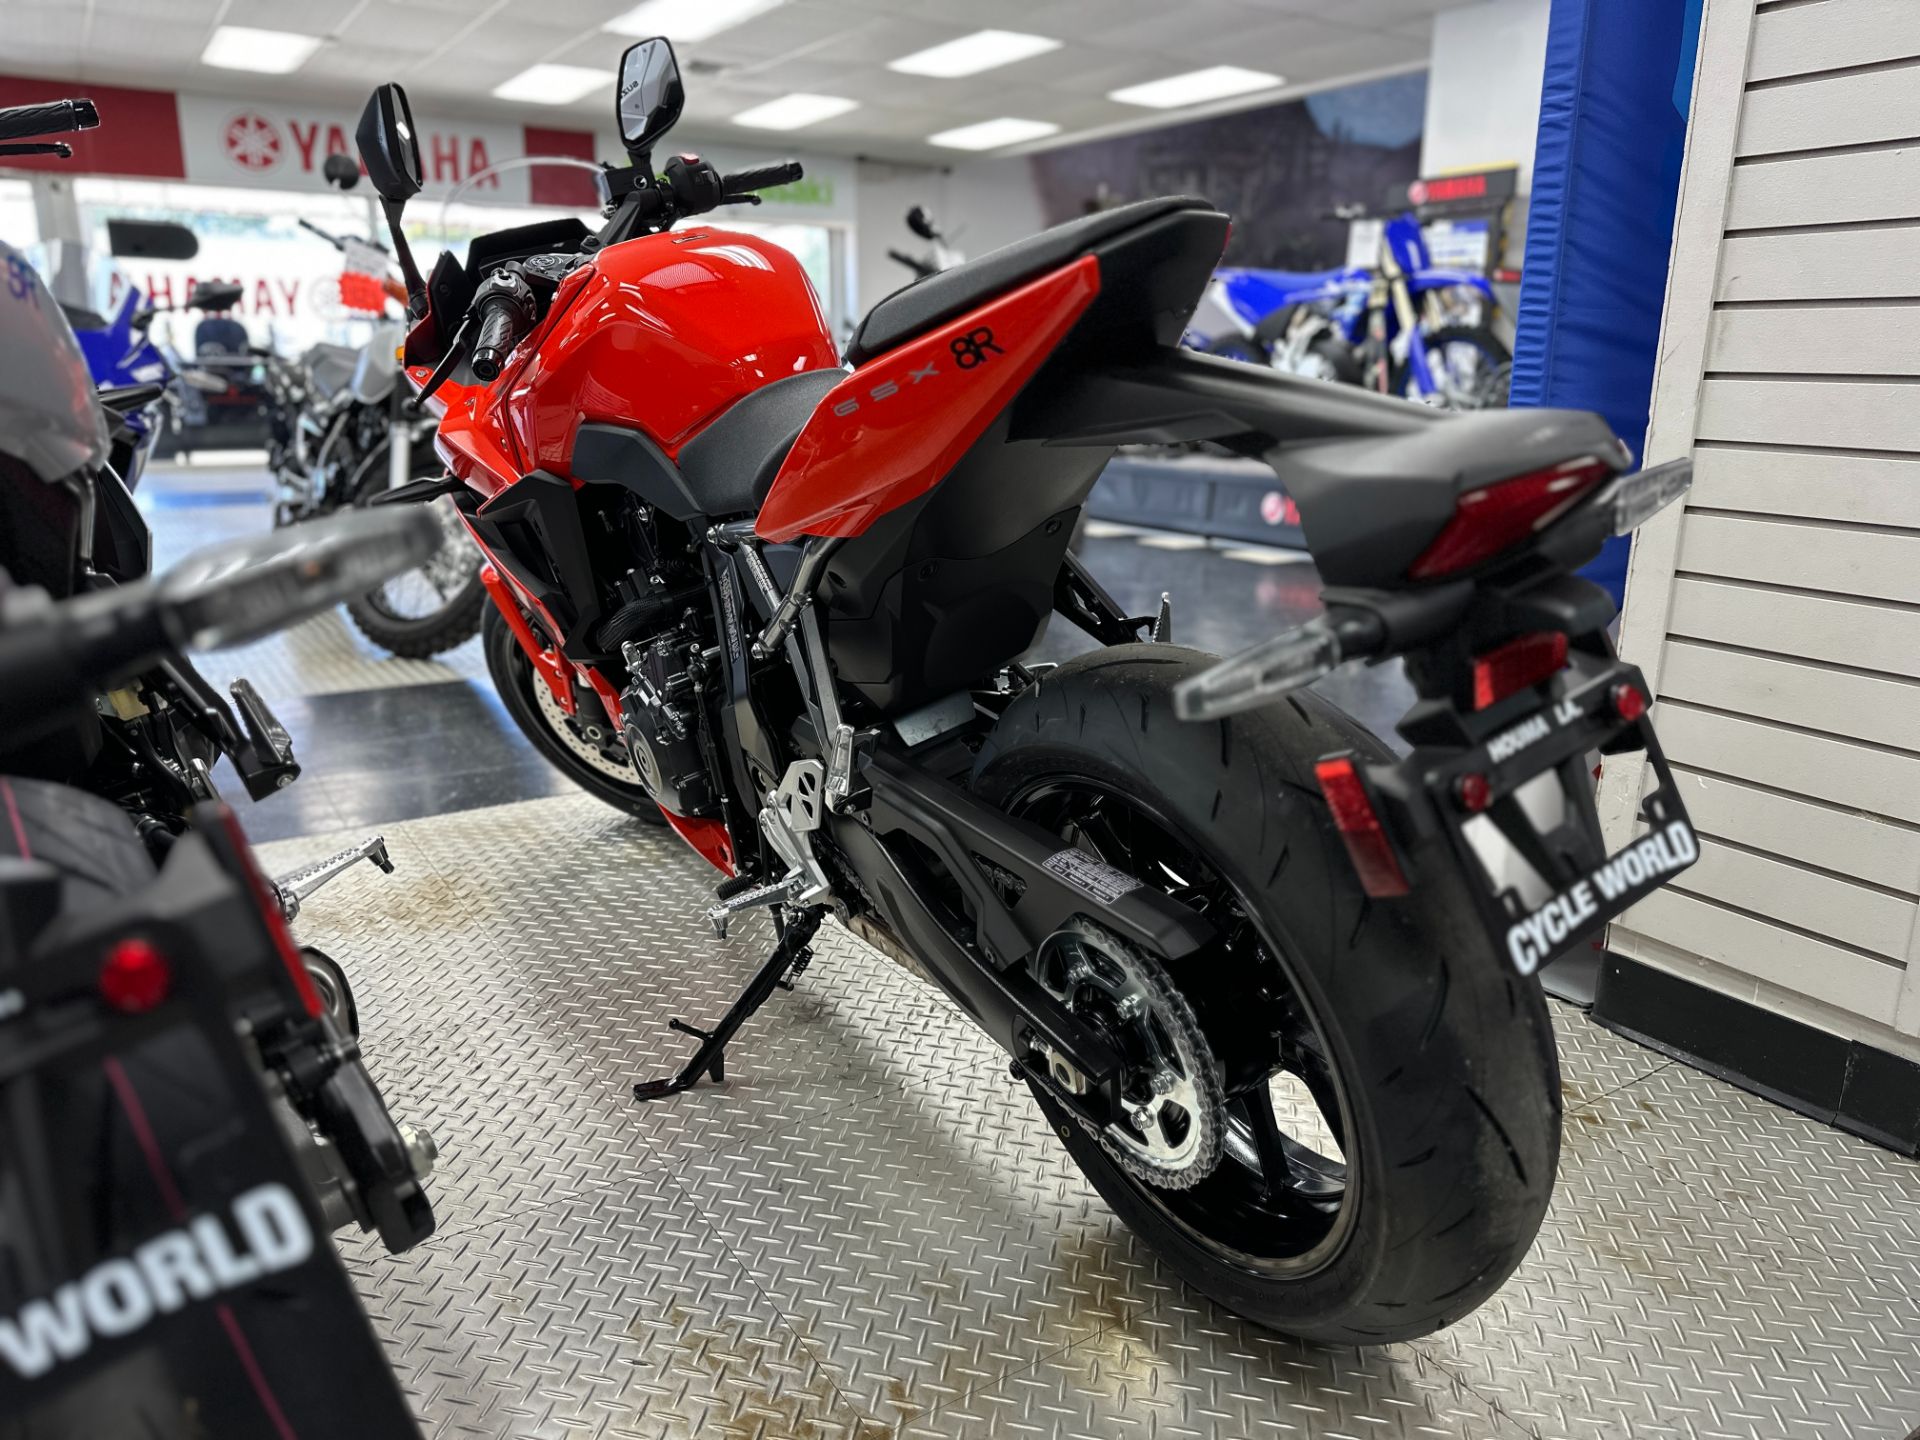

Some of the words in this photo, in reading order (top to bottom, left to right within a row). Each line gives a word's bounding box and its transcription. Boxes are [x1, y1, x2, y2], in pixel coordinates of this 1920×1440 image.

[289, 119, 499, 188] YAHA
[950, 326, 1006, 370] 8R
[1507, 883, 1597, 976] CYCLE
[1592, 820, 1697, 901] WORLD
[0, 1182, 314, 1379] WORLD
